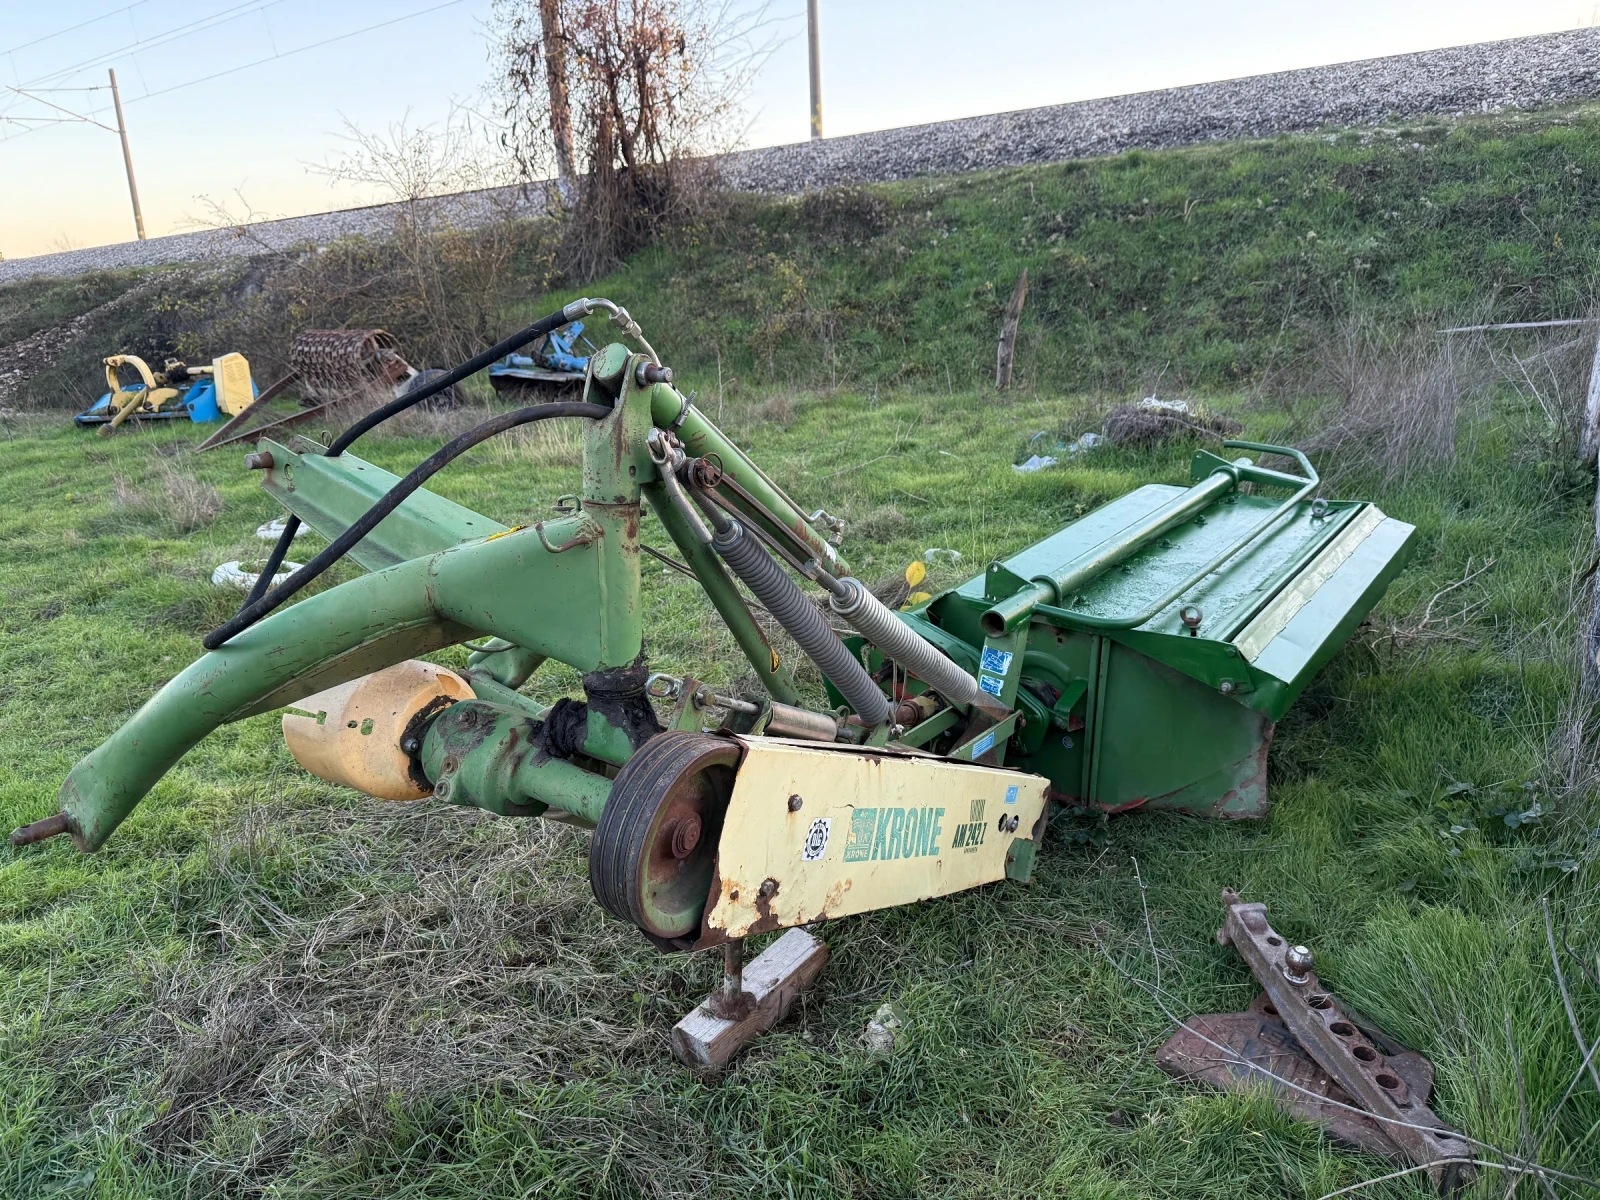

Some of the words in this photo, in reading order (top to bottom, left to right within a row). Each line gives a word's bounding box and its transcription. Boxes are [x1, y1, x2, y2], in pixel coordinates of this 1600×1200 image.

[871, 807, 945, 861] KRONE
[952, 824, 968, 848] AM
[965, 822, 982, 846] 242
[980, 822, 988, 844] Z
[845, 849, 868, 858] KRONE
